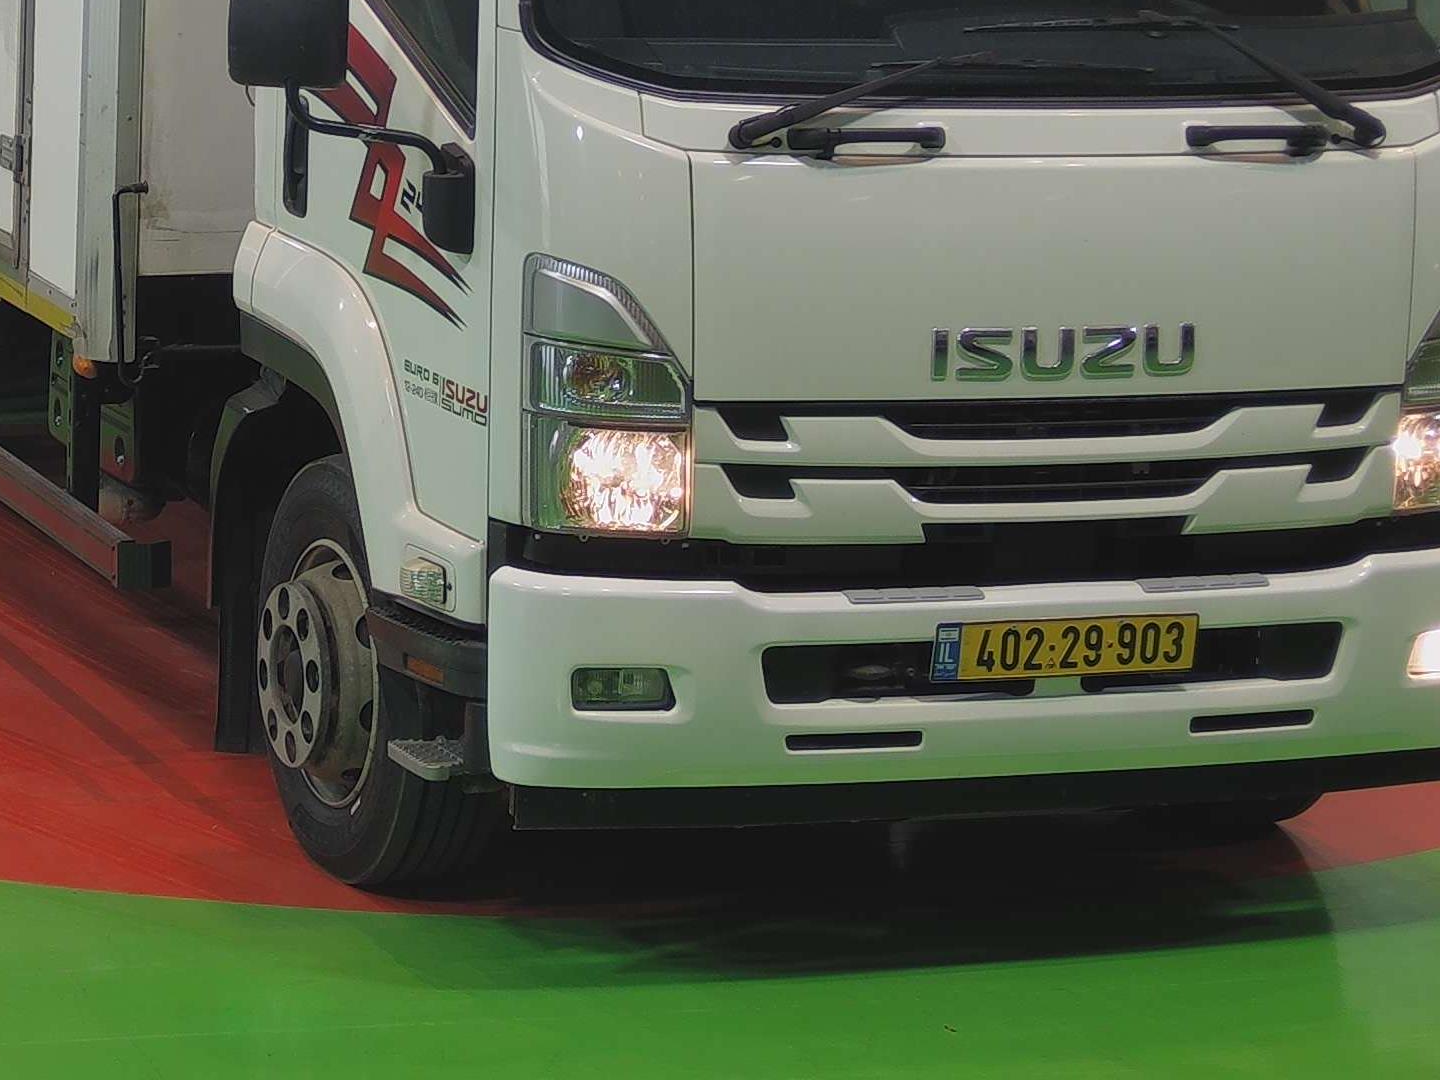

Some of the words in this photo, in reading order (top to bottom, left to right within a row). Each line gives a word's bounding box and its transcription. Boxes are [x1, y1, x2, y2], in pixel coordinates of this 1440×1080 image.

[930, 322, 1196, 382] ISUZU
[403, 358, 431, 382] EURO
[441, 376, 488, 414] ISUZU
[441, 397, 488, 427] SUMO
[938, 642, 954, 663] IL
